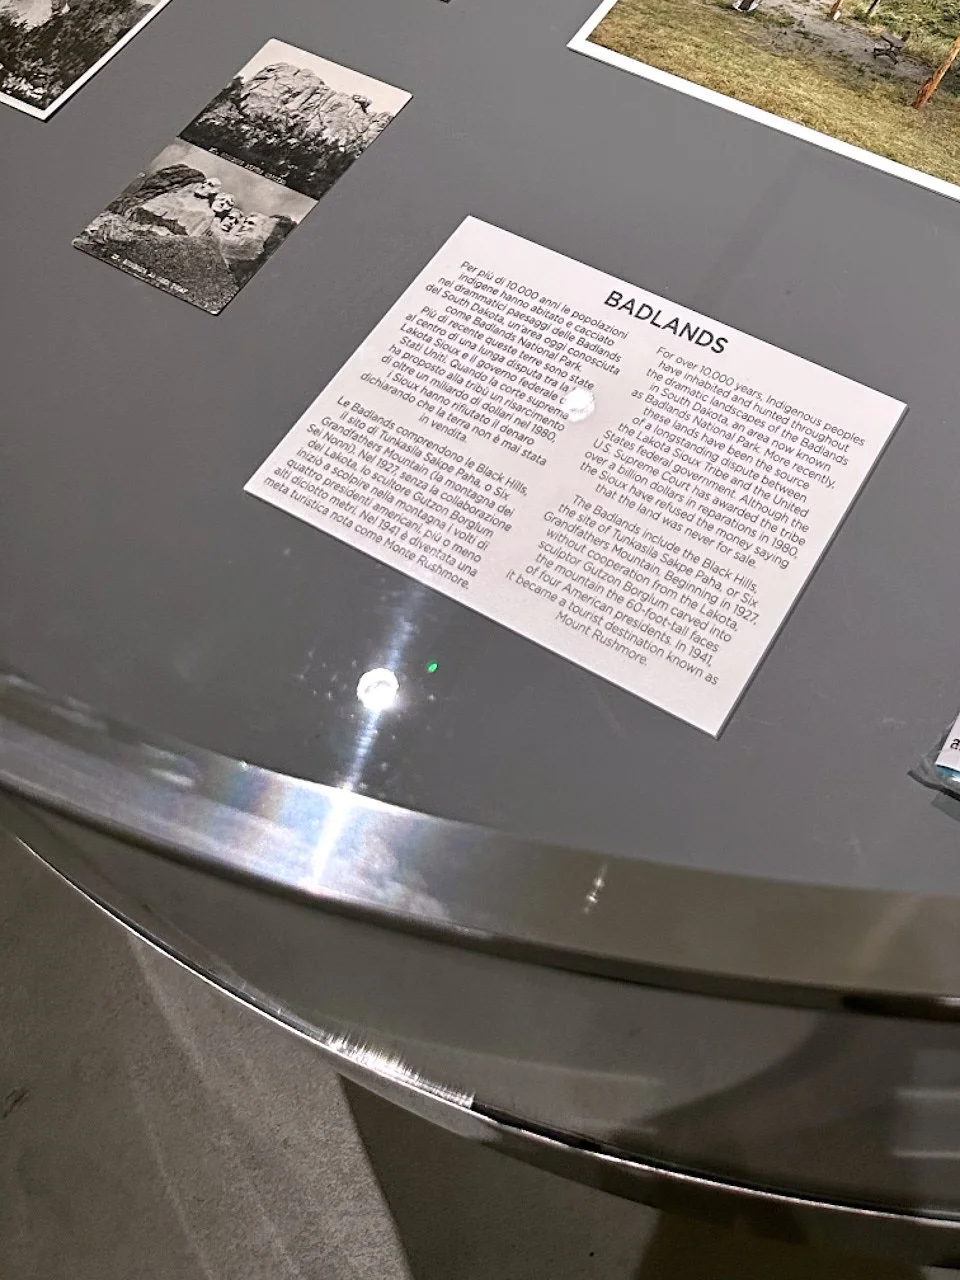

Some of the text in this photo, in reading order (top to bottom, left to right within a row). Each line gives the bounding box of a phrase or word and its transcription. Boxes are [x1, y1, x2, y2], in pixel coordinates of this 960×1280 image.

[459, 260, 629, 339] Per più di 10.000 anni le popolazioni
[603, 290, 728, 353] BADLANDS
[630, 389, 644, 399] as
[644, 393, 691, 421] Badlands
[691, 415, 736, 440] National
[763, 447, 790, 467] More
[645, 367, 849, 466] the dramatic landscapes of the Badlands
[648, 383, 659, 392] in
[659, 387, 691, 407] South
[731, 421, 745, 432] an
[746, 428, 770, 443] area
[770, 439, 795, 454] now
[795, 447, 831, 471] known
[655, 345, 675, 359] For
[674, 356, 698, 370] over
[698, 364, 734, 386] 10,000
[765, 394, 822, 426] Indigenous
[822, 422, 865, 446] peoples
[657, 359, 850, 452] have inhabited and hunted throughout
[602, 429, 635, 450] States
[635, 444, 673, 467] federal
[738, 494, 789, 523] Although
[790, 517, 809, 532] the
[617, 422, 810, 517] the Lakota Sioux Tribe and the United
[631, 416, 807, 503] of a longstanding dispute between
[642, 406, 810, 489] these lands have been the source
[572, 493, 592, 511] The
[591, 504, 641, 535] Badlands
[641, 528, 681, 554] include
[681, 548, 700, 564] the
[701, 557, 732, 579] Black
[579, 461, 789, 569] the Sioux have refused the money saying
[594, 483, 617, 499] that
[617, 493, 636, 509] the
[636, 502, 662, 520] land
[661, 516, 683, 531] was
[683, 527, 715, 546] never
[715, 540, 733, 555] for
[613, 448, 659, 476] Supreme
[660, 470, 691, 491] Court
[691, 484, 711, 501] has
[711, 496, 760, 523] awarded
[759, 517, 778, 533] the
[779, 527, 805, 546] tribe
[534, 552, 719, 652] the mountain the 60-foot-tall faces
[537, 540, 732, 642] sculptor Gutzon Borglum carved into
[543, 510, 610, 550] Grandfathers
[663, 569, 719, 605] Beginning
[719, 597, 731, 610] in
[546, 528, 586, 553] without
[586, 549, 650, 585] cooperation
[650, 579, 678, 599] from
[679, 593, 698, 609] the
[557, 503, 576, 518] the
[576, 513, 597, 528] site
[597, 523, 612, 534] of
[659, 552, 693, 576] Sakpe
[725, 587, 740, 597] or
[739, 592, 758, 608] Six
[505, 568, 719, 685] it became a tourist destination known as
[524, 565, 540, 576] of
[537, 569, 562, 587] four
[560, 582, 613, 615] American
[674, 639, 686, 652] In
[554, 610, 591, 635] Mount
